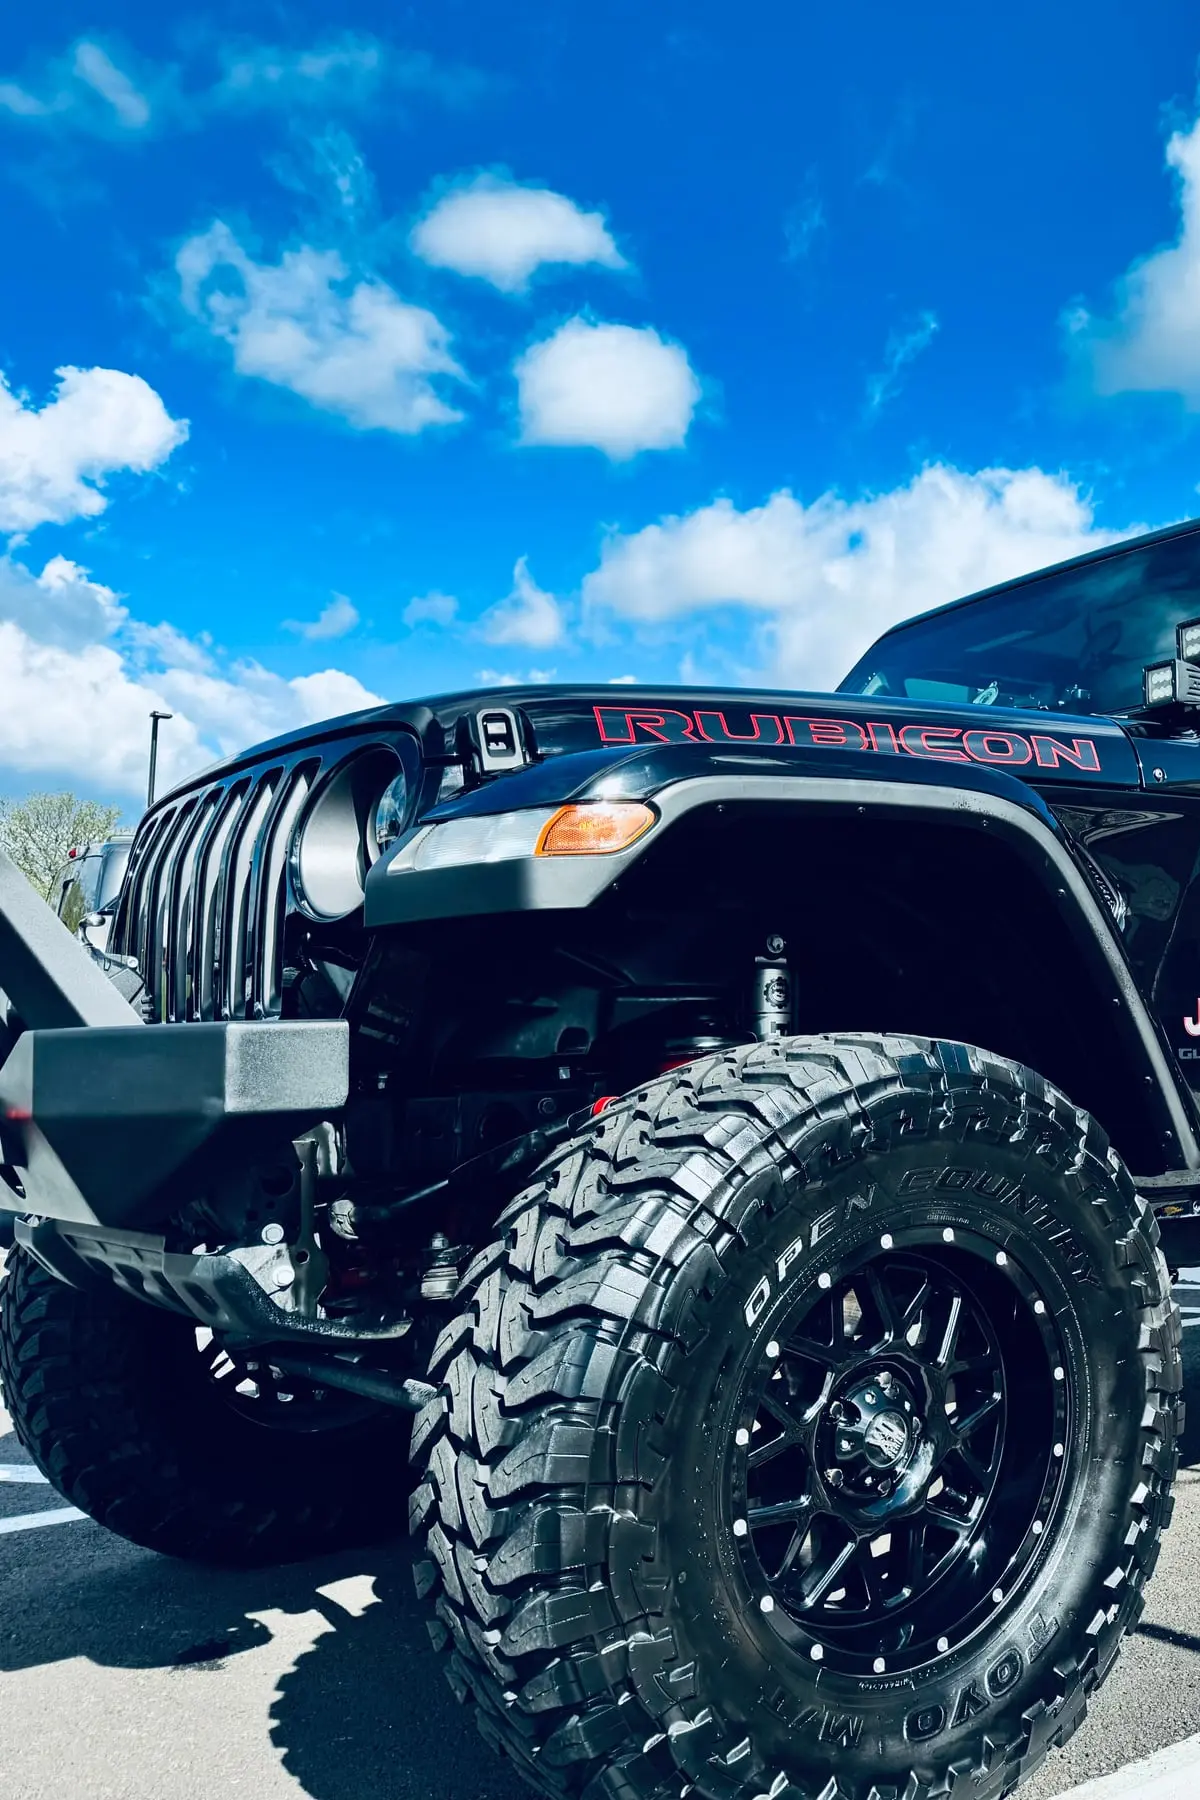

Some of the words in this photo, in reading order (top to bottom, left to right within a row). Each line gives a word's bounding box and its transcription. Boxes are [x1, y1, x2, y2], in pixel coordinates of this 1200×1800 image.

[592, 705, 1102, 772] RUBICON
[743, 1182, 876, 1329] OPEN
[895, 1164, 1103, 1292] COUNTRY
[902, 1612, 1061, 1743] TOYO
